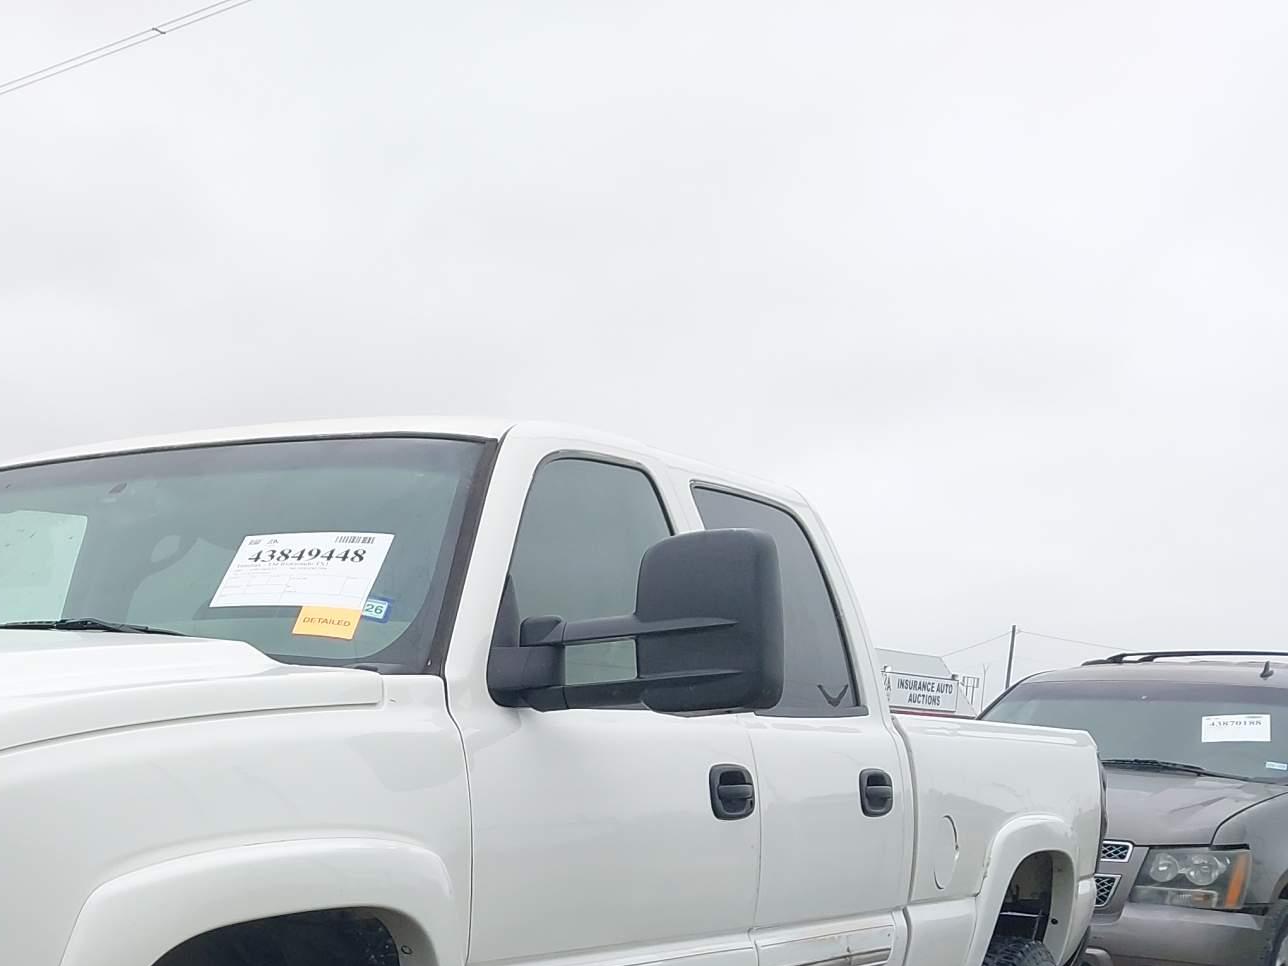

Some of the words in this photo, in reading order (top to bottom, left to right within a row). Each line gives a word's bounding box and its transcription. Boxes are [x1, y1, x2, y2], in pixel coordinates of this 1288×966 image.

[248, 548, 367, 563] 43849448
[365, 603, 384, 614] 26
[302, 617, 351, 627] DETAILED
[897, 678, 935, 692] INSURANCE
[936, 683, 953, 694] AUTO
[908, 694, 940, 705] AUCTIONS
